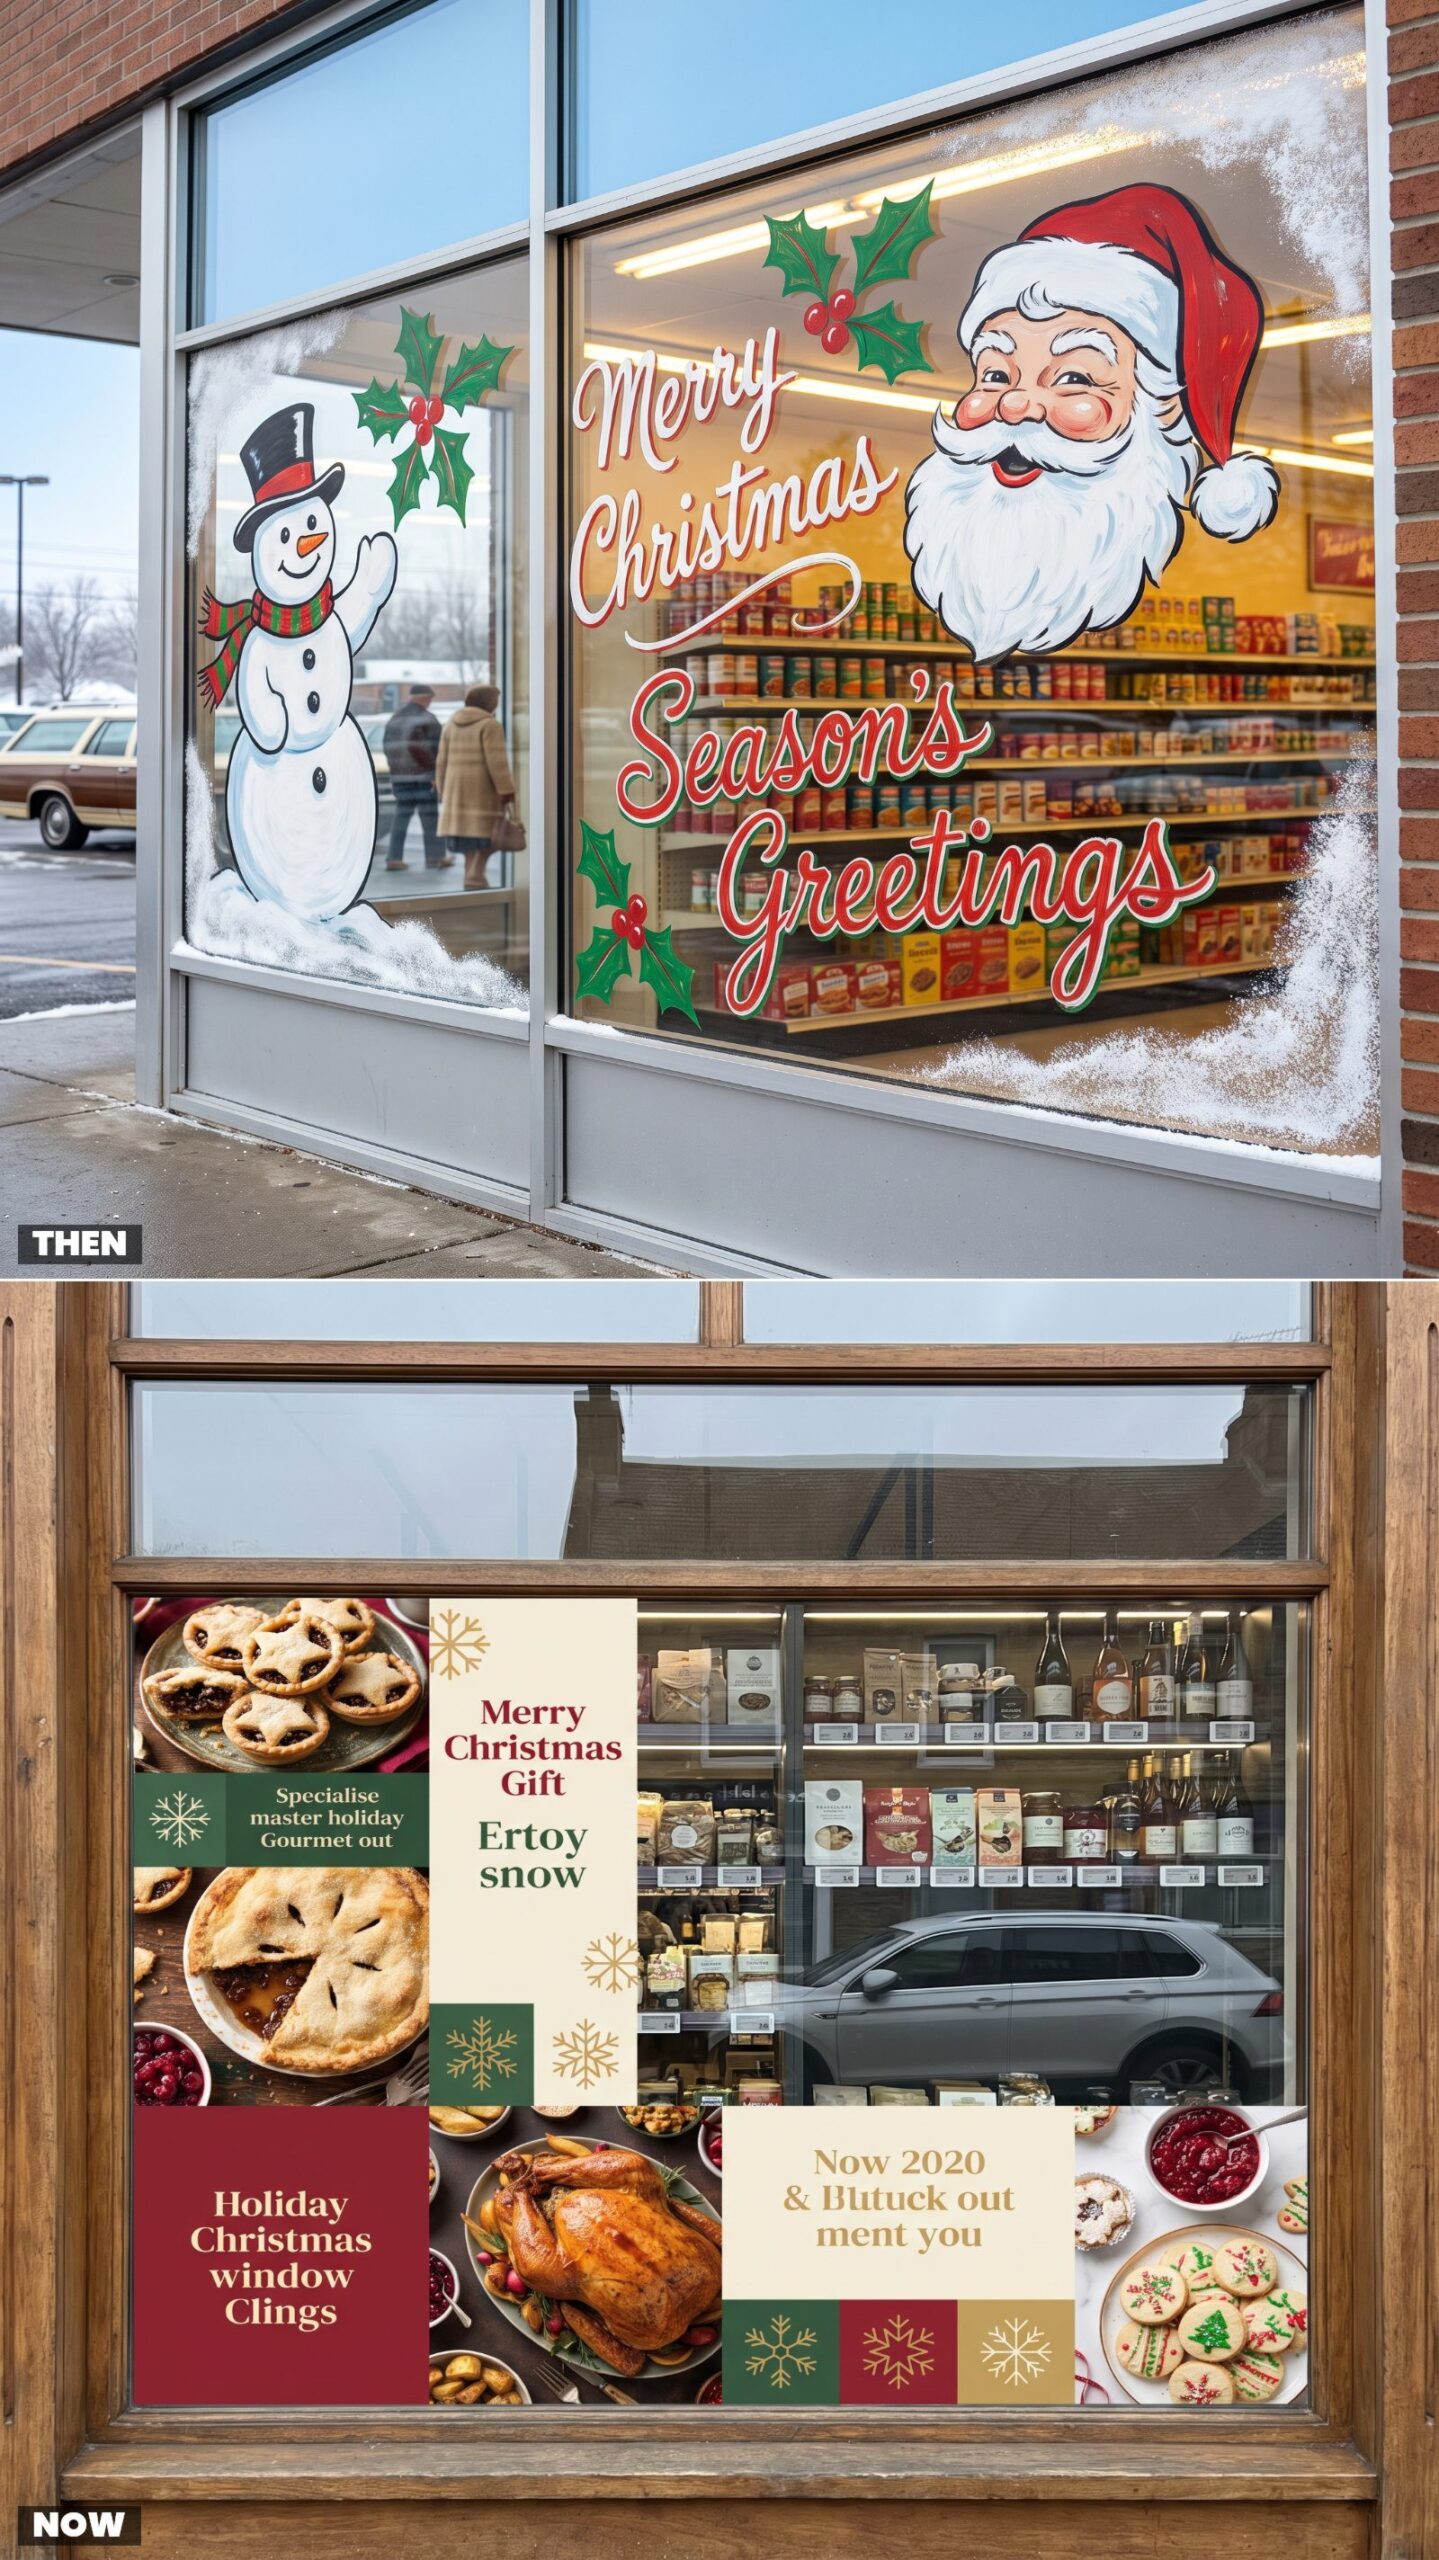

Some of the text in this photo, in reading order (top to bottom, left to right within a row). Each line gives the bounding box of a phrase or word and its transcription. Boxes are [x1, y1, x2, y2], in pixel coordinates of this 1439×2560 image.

[572, 326, 799, 473] Merry
[569, 435, 900, 628] Christmas
[616, 667, 995, 827] Season's
[717, 809, 1219, 1018] Greetings
[480, 1699, 587, 1733] Merry
[444, 1733, 623, 1761] Christmas
[501, 1769, 567, 1796] Gift
[275, 1787, 380, 1808] Specialise
[250, 1809, 405, 1830] master holiday
[260, 1832, 394, 1848] Gourmet out
[478, 1821, 588, 1860] Ertoy
[480, 1866, 587, 1889] snow
[813, 2149, 986, 2175] Now 2020
[213, 2190, 349, 2225] Holiday
[783, 2184, 811, 2211] &
[957, 2186, 1015, 2211] out
[190, 2226, 372, 2253] Christmas
[816, 2223, 983, 2255] ment you
[209, 2262, 355, 2288] window
[225, 2298, 338, 2333] Clings
